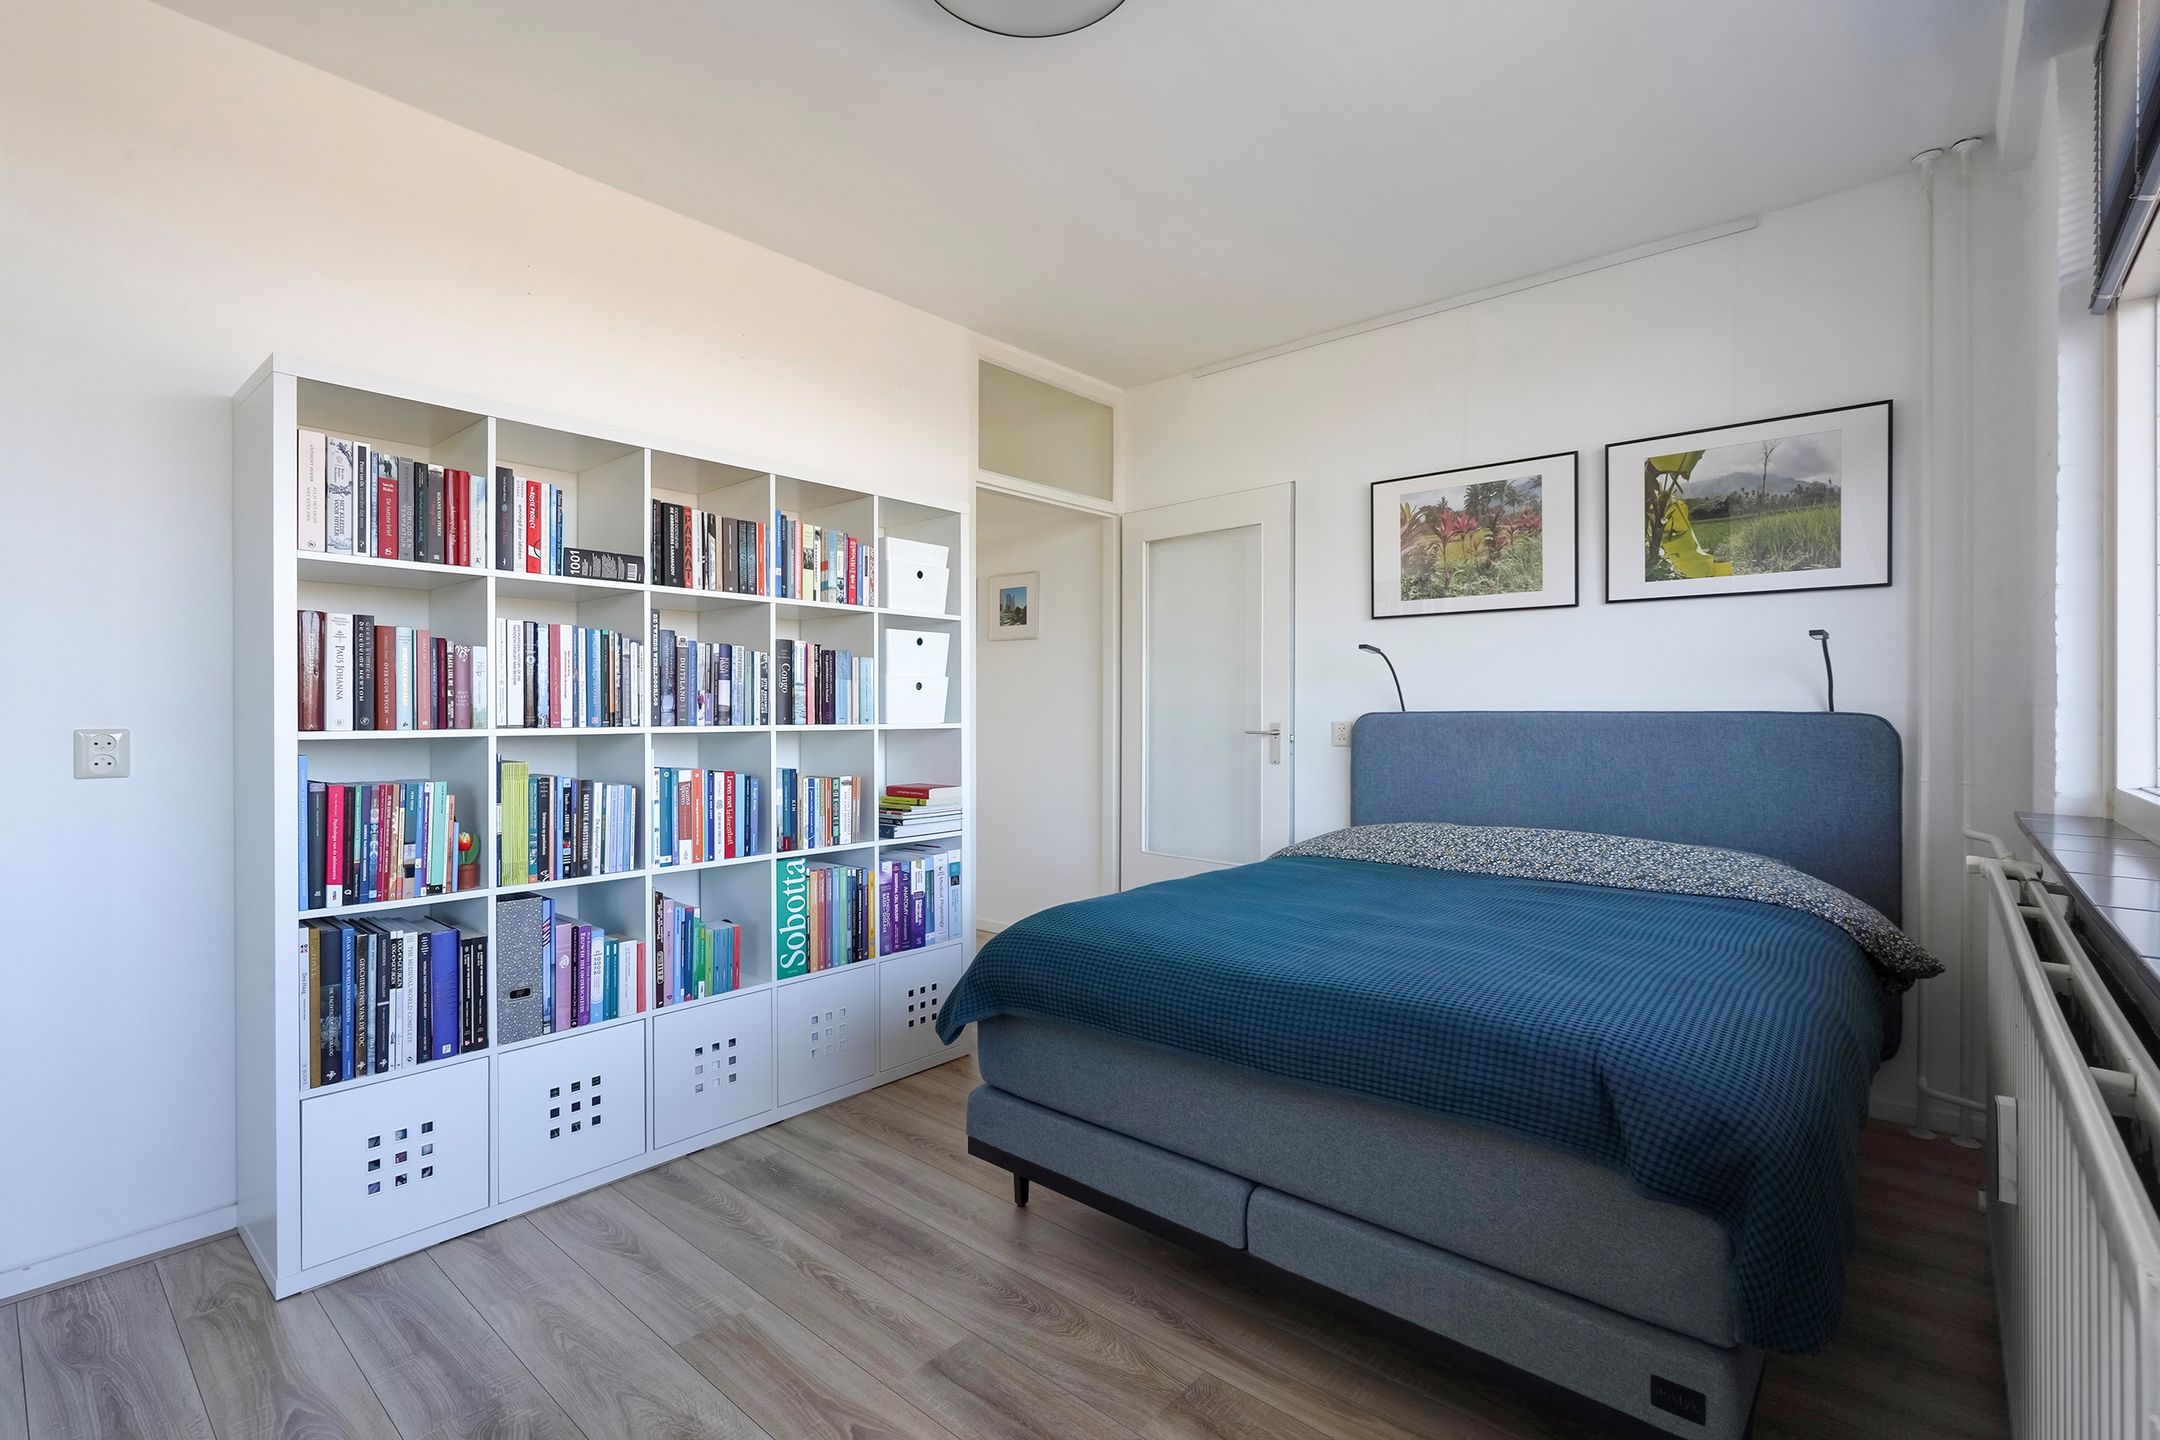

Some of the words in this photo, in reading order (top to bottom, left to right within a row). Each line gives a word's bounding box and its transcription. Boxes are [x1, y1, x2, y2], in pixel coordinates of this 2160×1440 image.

[570, 550, 581, 575] 1001
[653, 614, 658, 623] DE
[335, 645, 345, 664] PAUS
[335, 665, 345, 700] JOHANNA
[778, 663, 790, 693] Congo
[779, 858, 806, 968] Sobotta
[359, 1022, 365, 1031] DE
